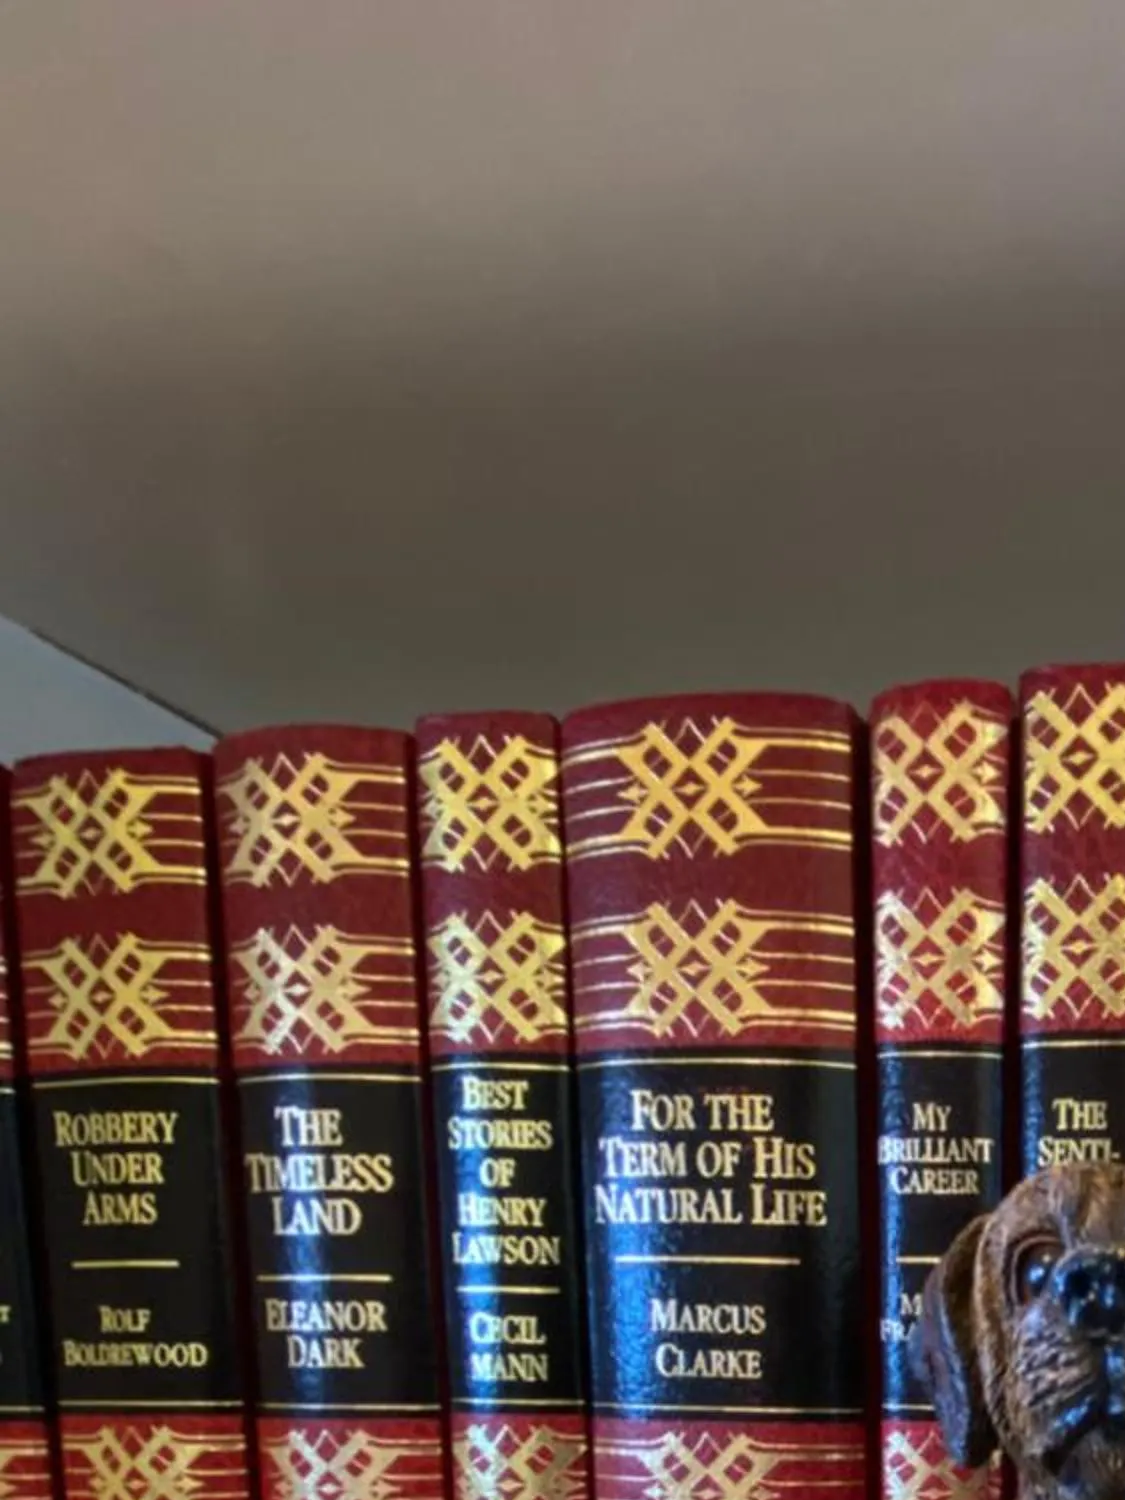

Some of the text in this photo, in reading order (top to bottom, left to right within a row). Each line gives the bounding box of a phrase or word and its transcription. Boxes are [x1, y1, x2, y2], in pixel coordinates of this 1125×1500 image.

[462, 1074, 529, 1111] BEST
[274, 1105, 343, 1147] THE
[630, 1089, 775, 1132] FOR THE
[912, 1102, 952, 1133] MY
[1051, 1097, 1108, 1131] THE
[52, 1110, 179, 1147] ROBBERY
[448, 1117, 553, 1152] STORIES
[598, 1136, 817, 1180] TERM OF HIS
[878, 1135, 994, 1165] BRILLIANT
[1038, 1135, 1121, 1167] SENTI-
[70, 1150, 165, 1186] UNDER
[244, 1152, 394, 1194] TIMELESS
[479, 1158, 516, 1188] OF
[891, 1168, 980, 1195] CAREER
[82, 1190, 158, 1227] ARMS
[272, 1197, 363, 1235] LAND
[458, 1196, 546, 1228] HENRY
[595, 1184, 828, 1227] NATURAL LIFE
[452, 1231, 561, 1266] LAWSON
[97, 1305, 151, 1333] ROLF
[264, 1298, 388, 1332] ELEANOR
[469, 1311, 546, 1345] CECIL
[649, 1298, 766, 1334] MARCUS
[62, 1340, 208, 1367] BOLDREWOOD
[287, 1335, 365, 1369] DARK
[471, 1353, 549, 1383] MANN
[655, 1342, 763, 1379] CLARKE
